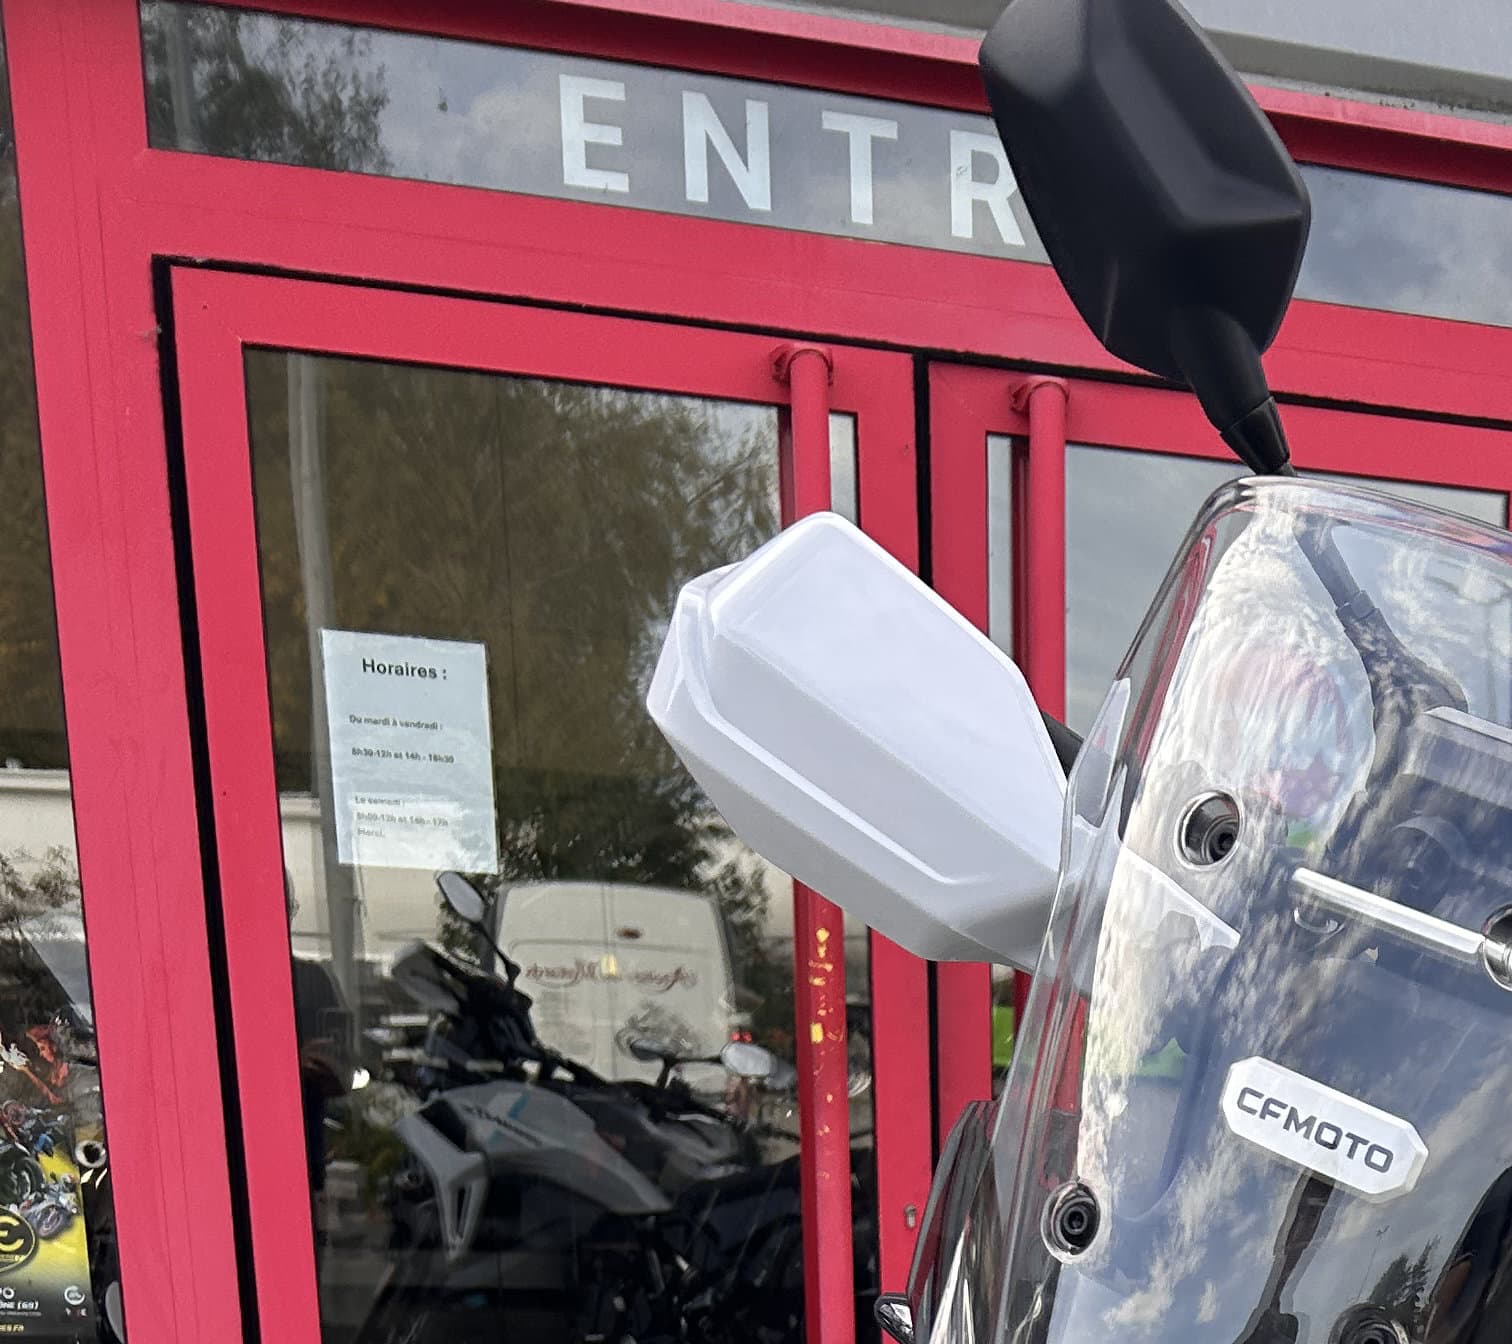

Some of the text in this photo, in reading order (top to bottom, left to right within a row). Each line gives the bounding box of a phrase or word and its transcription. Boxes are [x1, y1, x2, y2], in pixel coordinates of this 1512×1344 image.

[559, 73, 1026, 246] ENTR
[362, 658, 438, 680] Horaires
[1237, 1087, 1394, 1174] CFMOTO
